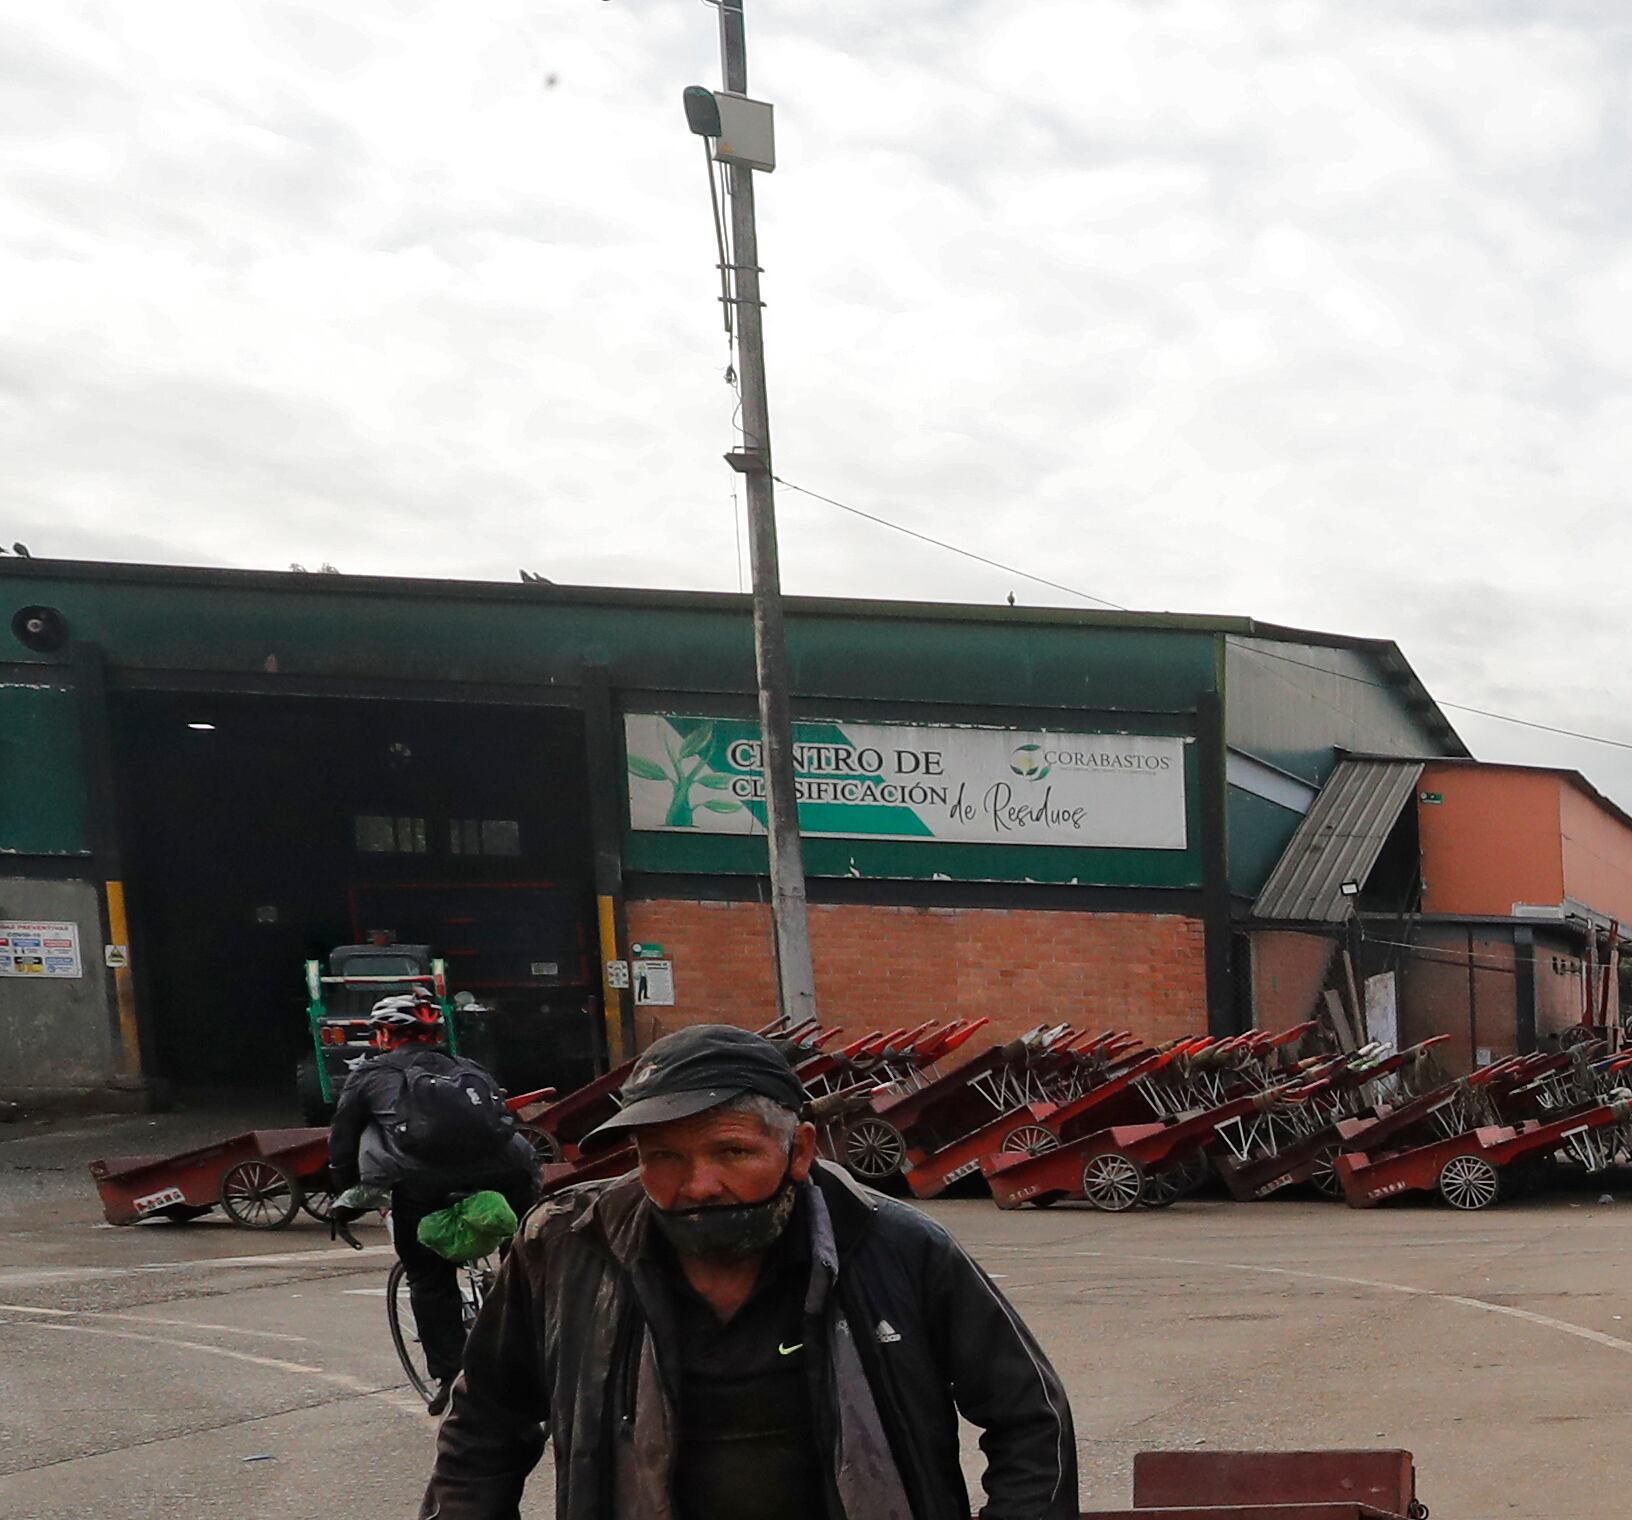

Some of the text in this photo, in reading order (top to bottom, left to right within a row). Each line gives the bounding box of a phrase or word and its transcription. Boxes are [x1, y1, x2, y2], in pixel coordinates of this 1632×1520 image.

[895, 750, 944, 775] DE
[1044, 751, 1170, 769] CORABASTOS
[732, 779, 948, 805] CLSIFICACIÓN
[950, 783, 976, 824] de
